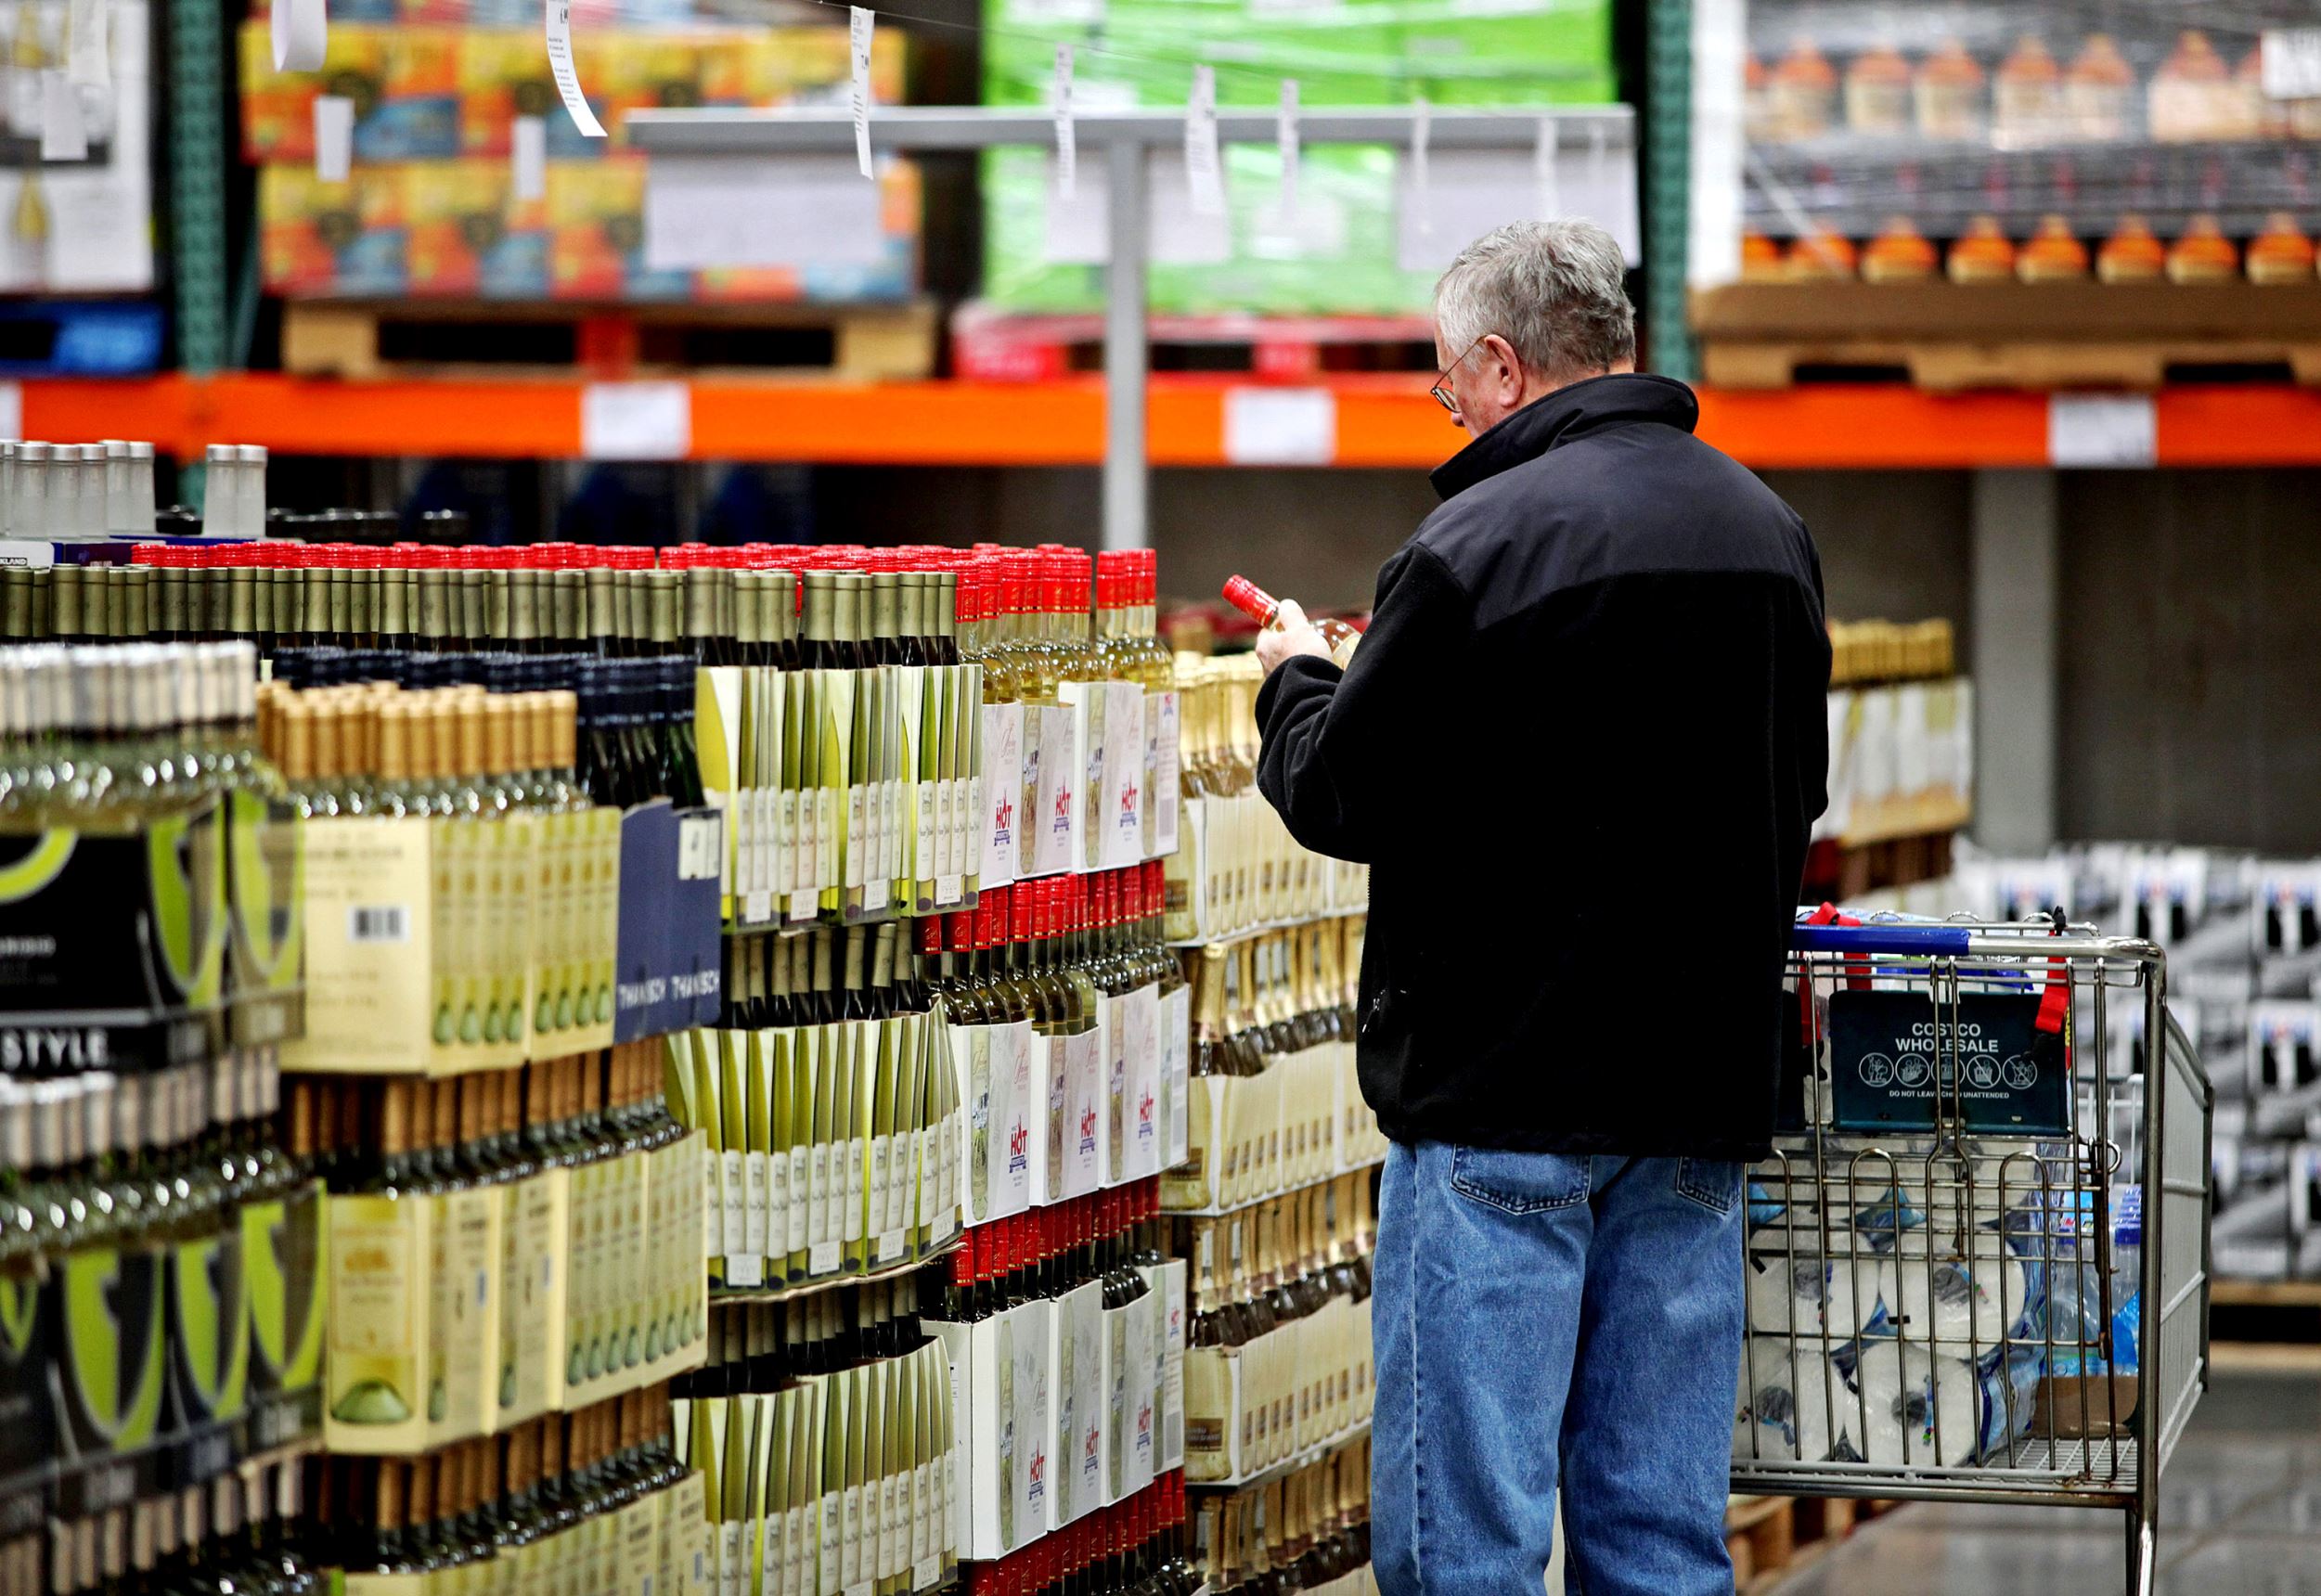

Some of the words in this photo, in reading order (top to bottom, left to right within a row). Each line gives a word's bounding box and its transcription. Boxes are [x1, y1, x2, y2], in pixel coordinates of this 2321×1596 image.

[996, 798, 1012, 830] HOT
[1055, 786, 1071, 817] HOT
[2, 1029, 109, 1067] STYLE
[1895, 1038, 1999, 1053] WHOESALE
[1080, 1105, 1096, 1139] HOT
[1010, 1123, 1027, 1156] HOT
[1085, 1425, 1099, 1458] HOT
[1030, 1448, 1045, 1484] HOT
